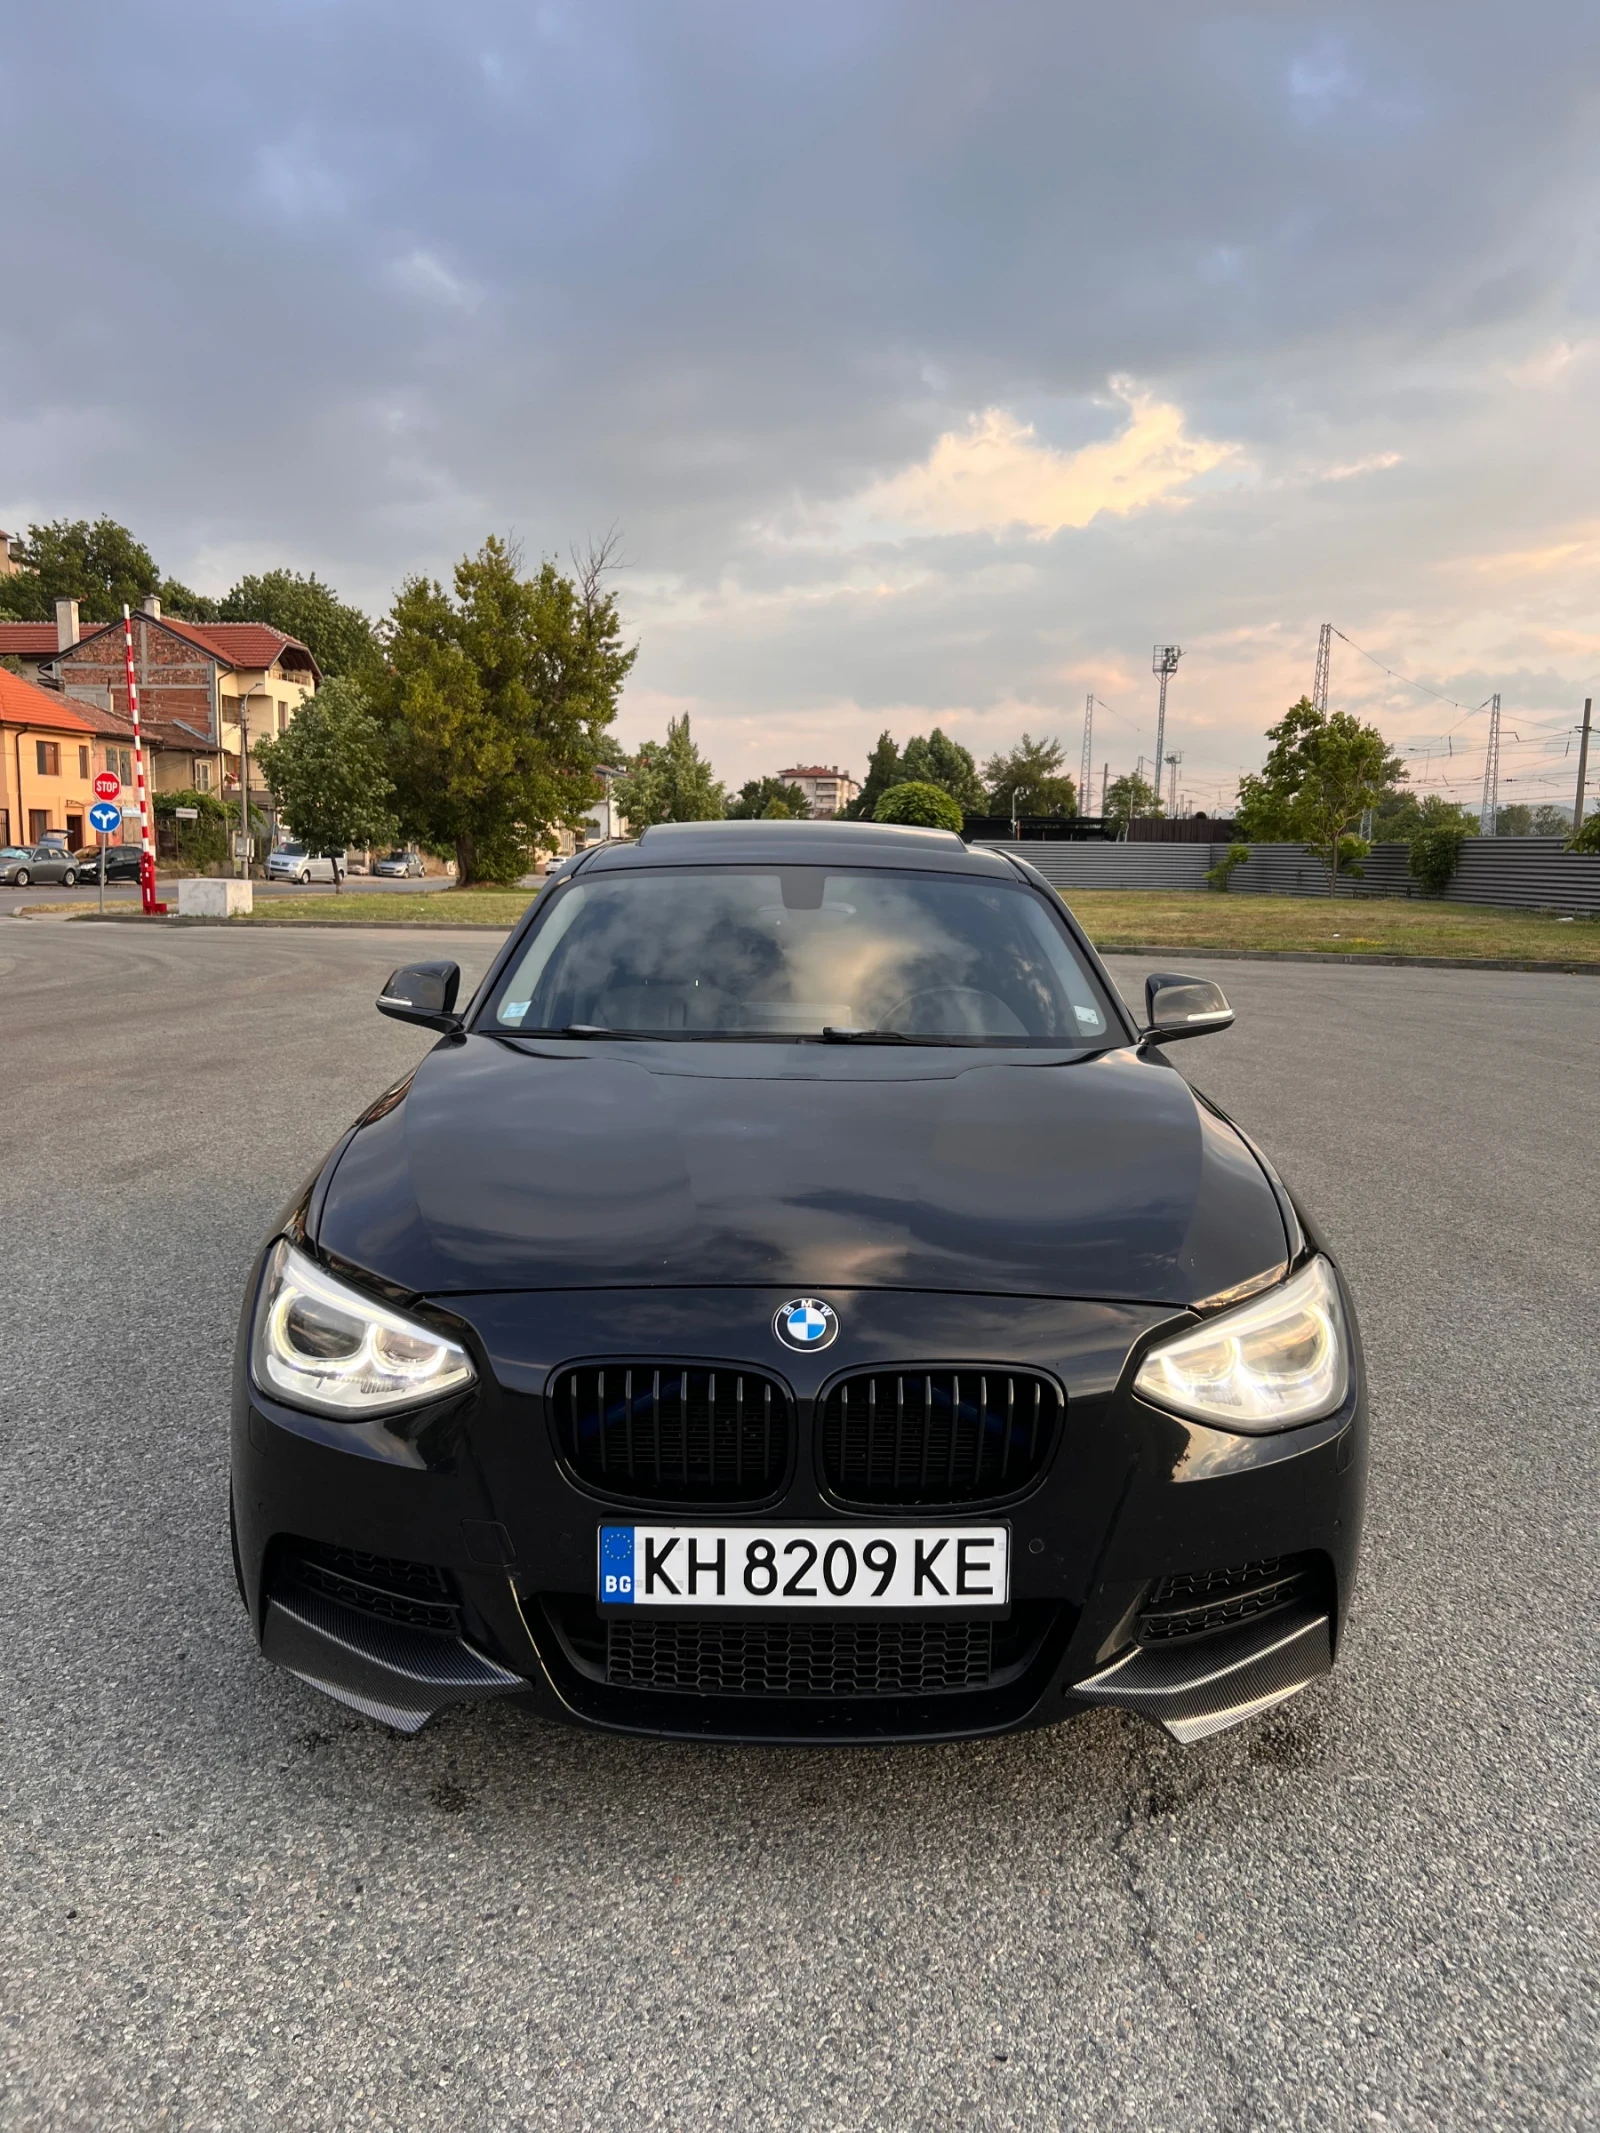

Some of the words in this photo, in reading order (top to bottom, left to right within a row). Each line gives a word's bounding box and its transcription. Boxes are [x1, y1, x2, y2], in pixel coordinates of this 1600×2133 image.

[96, 781, 118, 792] STOP
[782, 1300, 833, 1316] BMW
[644, 1536, 726, 1596] KH
[743, 1538, 898, 1597] 8209
[913, 1537, 995, 1597] KE
[605, 1575, 632, 1593] BG
